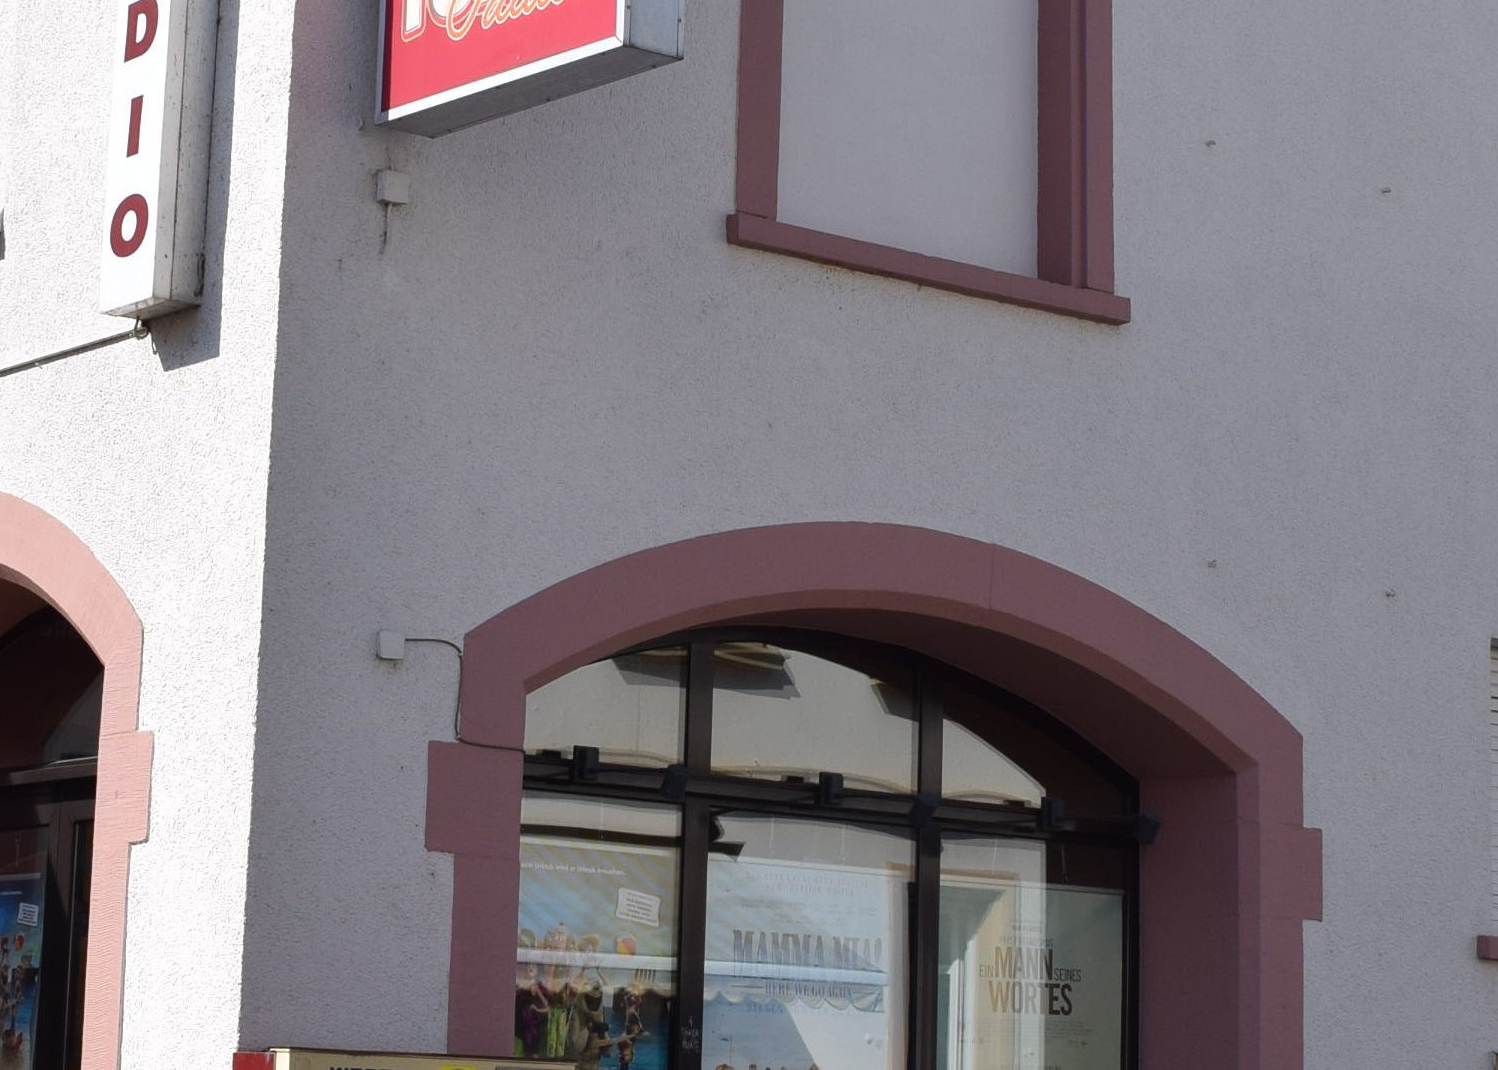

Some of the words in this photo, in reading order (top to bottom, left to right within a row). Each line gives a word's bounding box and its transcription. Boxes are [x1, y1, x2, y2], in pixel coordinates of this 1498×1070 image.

[733, 929, 825, 976] MAMMA
[979, 964, 994, 978] EIN
[995, 946, 1053, 980] MANN
[1054, 968, 1082, 982] SEINES
[988, 980, 1073, 1016] WORTES
